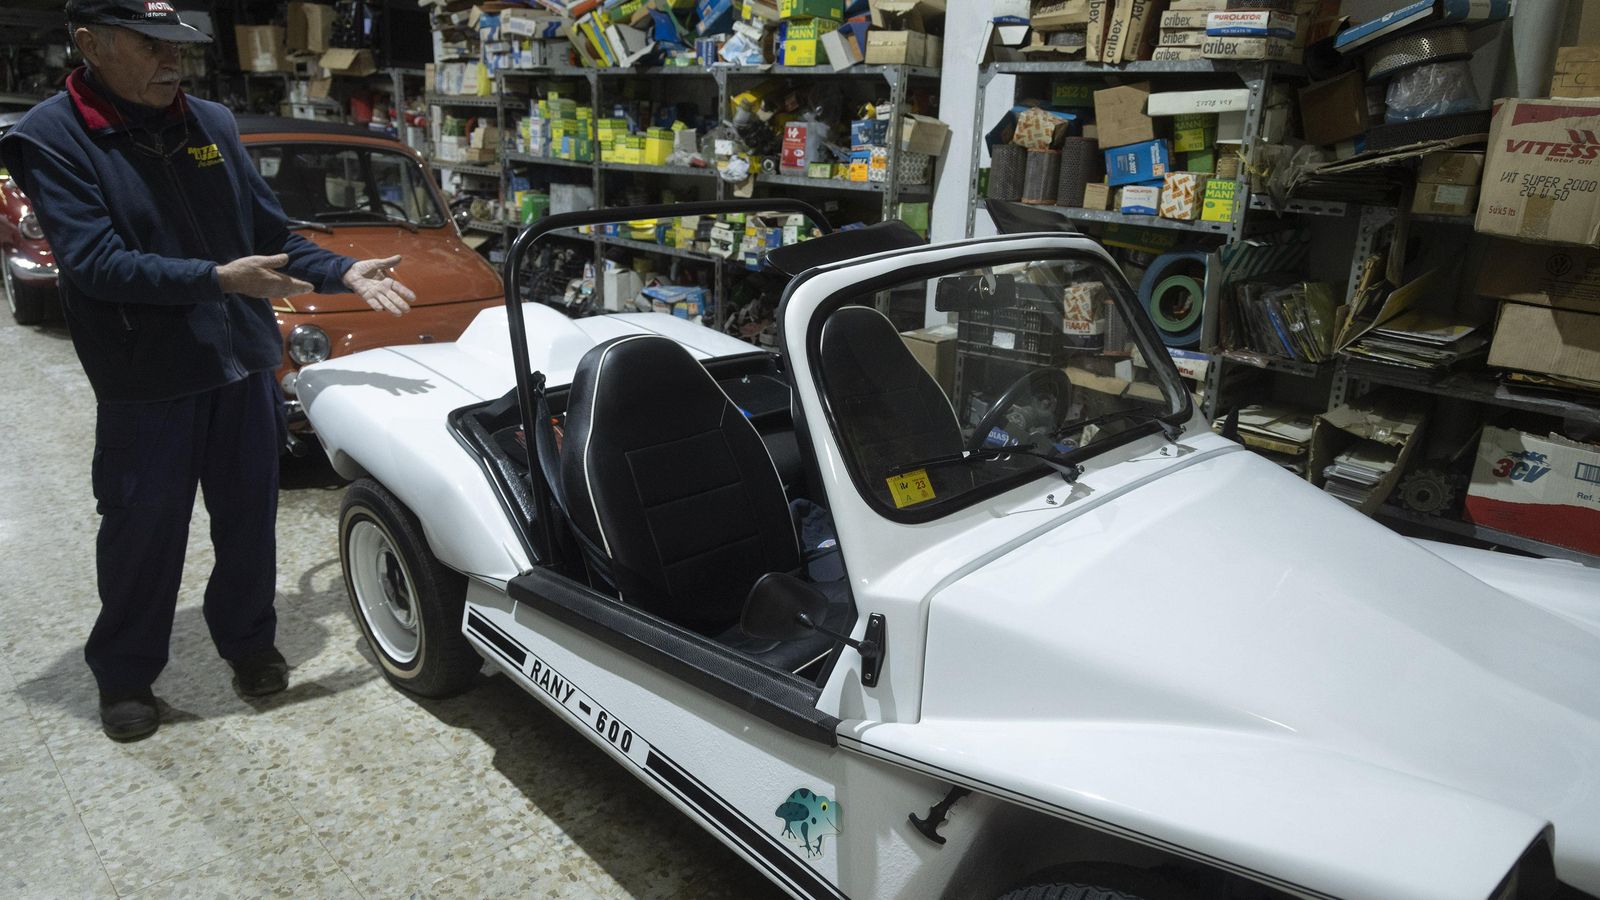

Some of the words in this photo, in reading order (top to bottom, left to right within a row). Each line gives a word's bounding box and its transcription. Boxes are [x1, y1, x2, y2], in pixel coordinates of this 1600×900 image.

[1163, 12, 1192, 27] cribex
[1213, 13, 1262, 21] PUROLATOR
[1106, 19, 1124, 59] cribex
[1162, 29, 1187, 44] cribex
[1203, 37, 1239, 55] cribex
[1155, 47, 1181, 61] cribex
[1545, 156, 1573, 164] Motor
[1206, 181, 1236, 191] FILTRO
[1500, 172, 1520, 184] VIT
[1522, 174, 1560, 188] SUPER
[1563, 178, 1598, 193] 2000
[1520, 185, 1536, 198] 20
[1492, 457, 1552, 484] 3CV
[915, 480, 926, 490] 23
[1576, 491, 1595, 503] Ref.
[530, 659, 576, 705] RANY
[595, 709, 633, 754] 600
